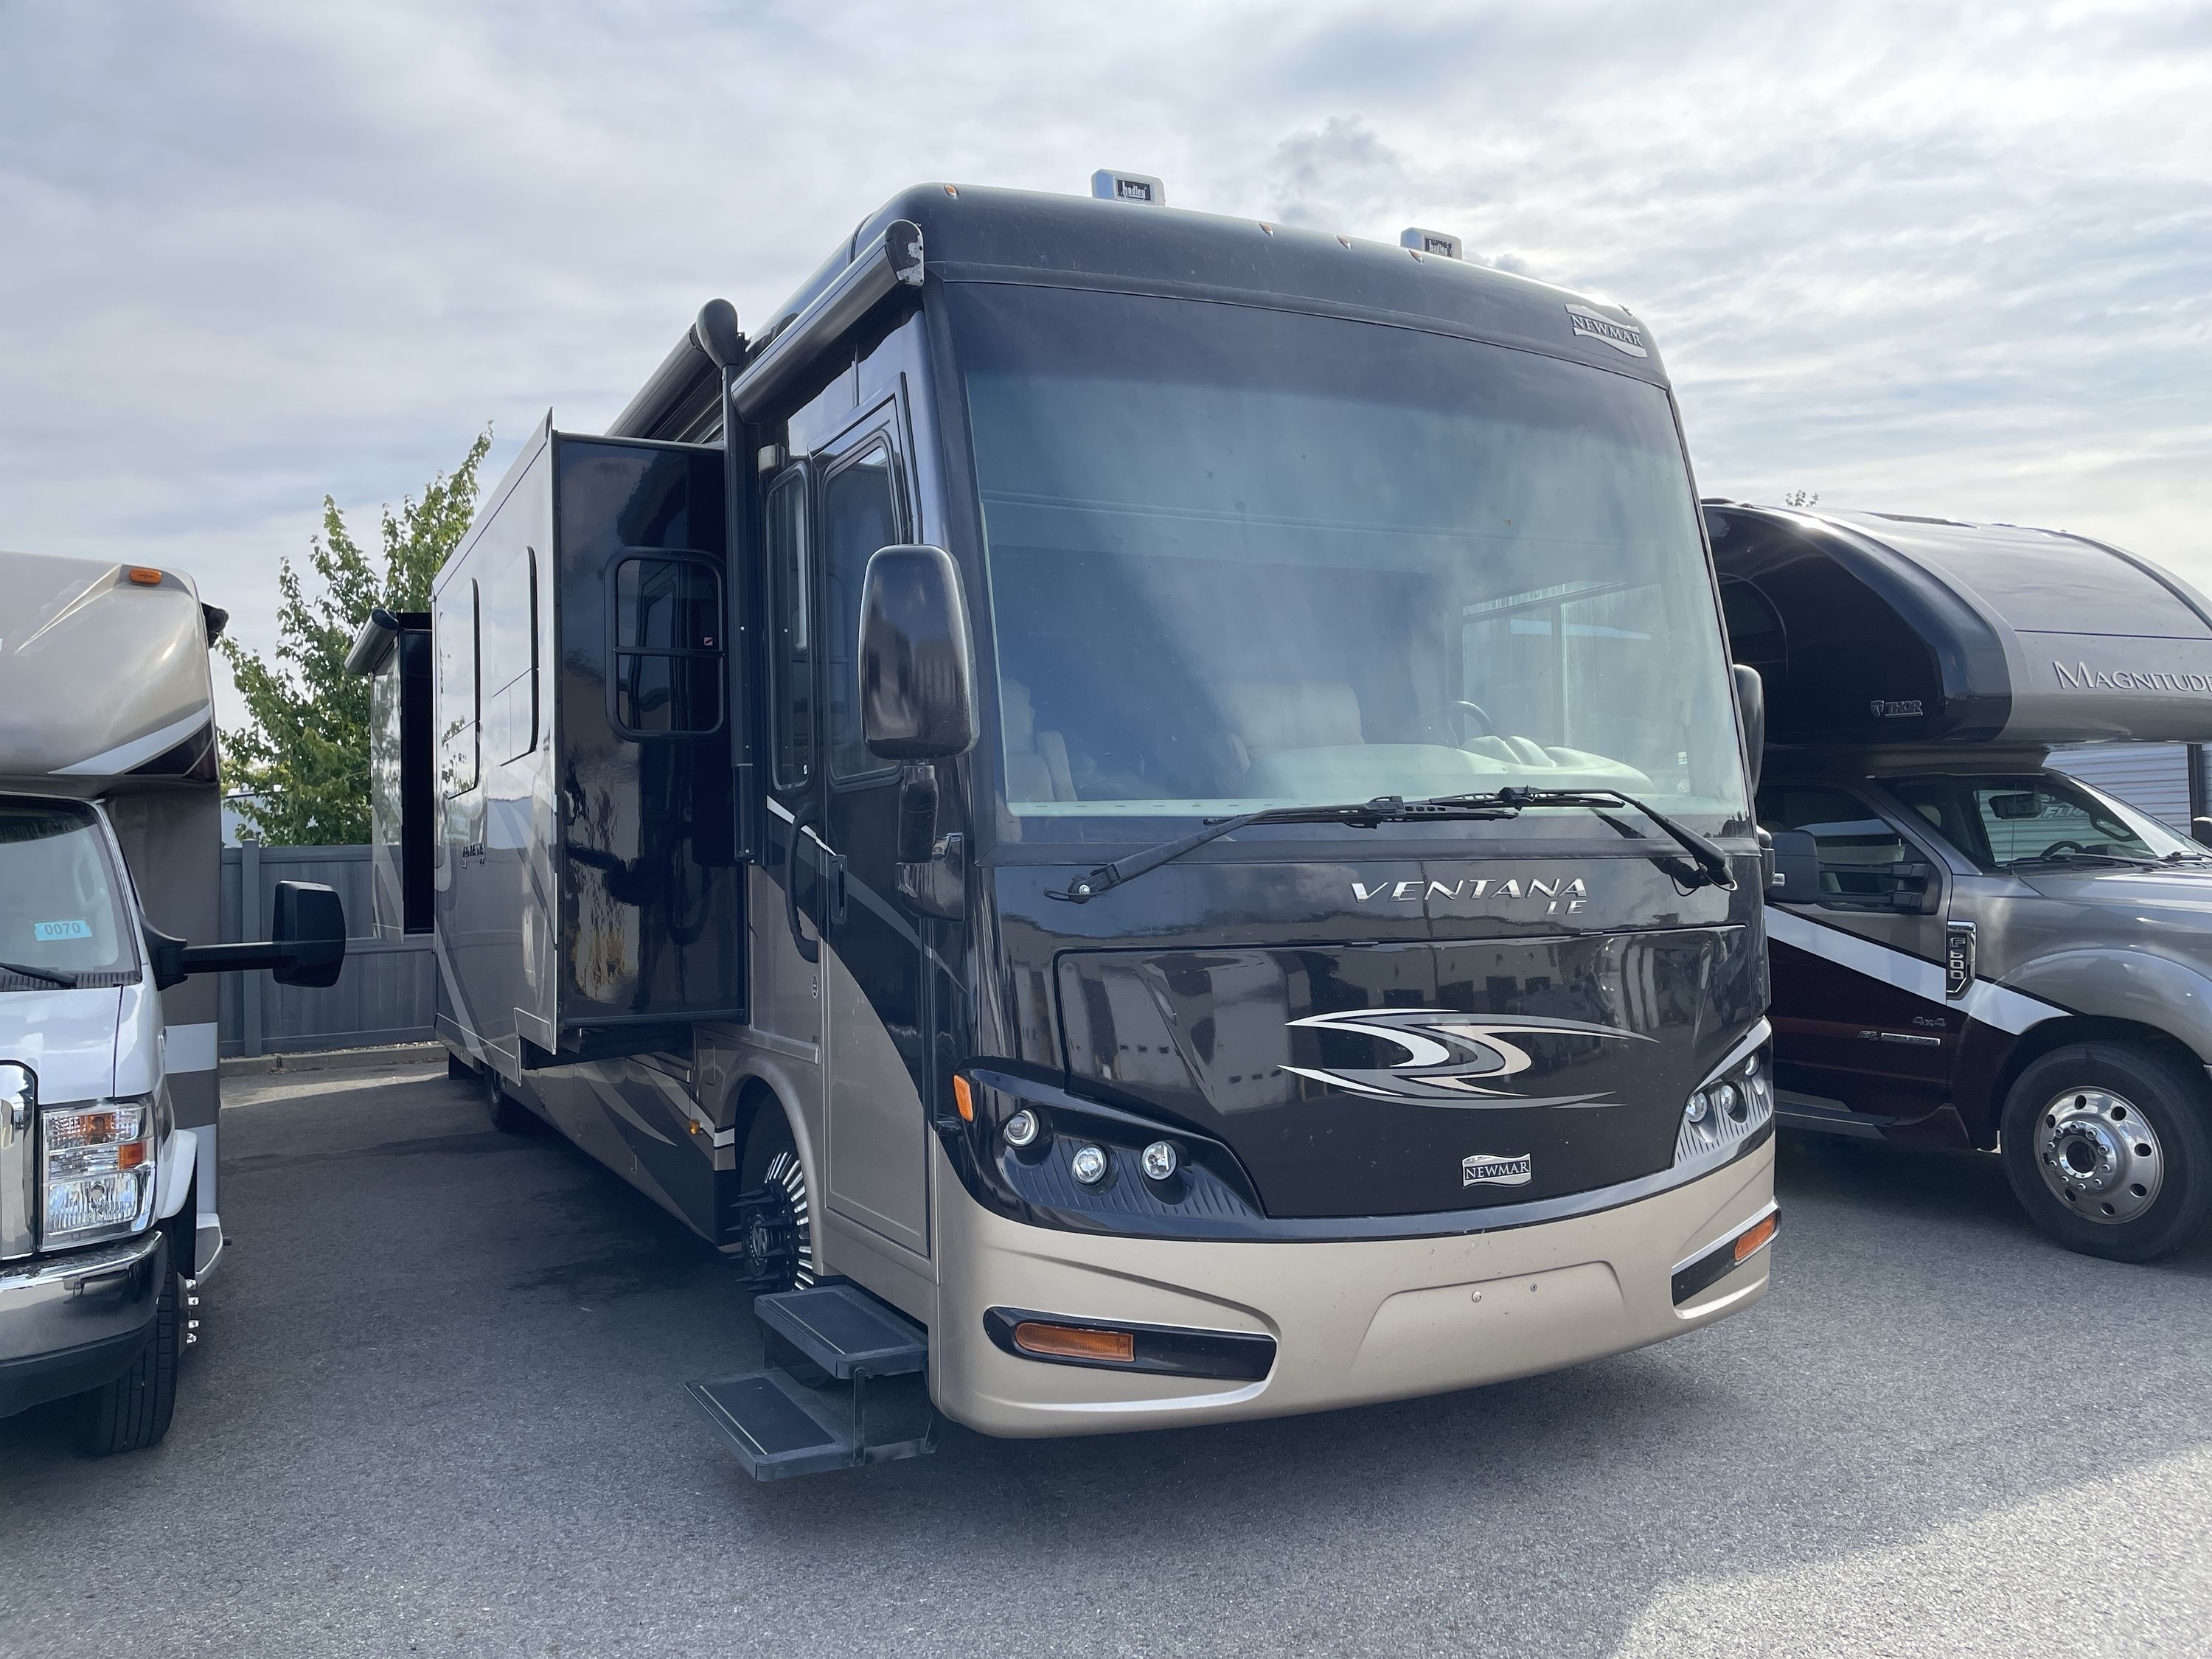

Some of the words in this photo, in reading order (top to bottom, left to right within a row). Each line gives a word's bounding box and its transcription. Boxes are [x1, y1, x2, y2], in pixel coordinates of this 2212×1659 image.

[1121, 181, 1147, 199] hadley
[1570, 314, 1644, 347] NEWMAR
[2052, 661, 2212, 692] MAGNITUDE
[1885, 700, 1923, 715] THOR
[1351, 877, 1587, 903] VENTANA
[1545, 900, 1587, 916] LE
[44, 922, 81, 935] 0070
[1465, 1161, 1530, 1180] NEWMAR
